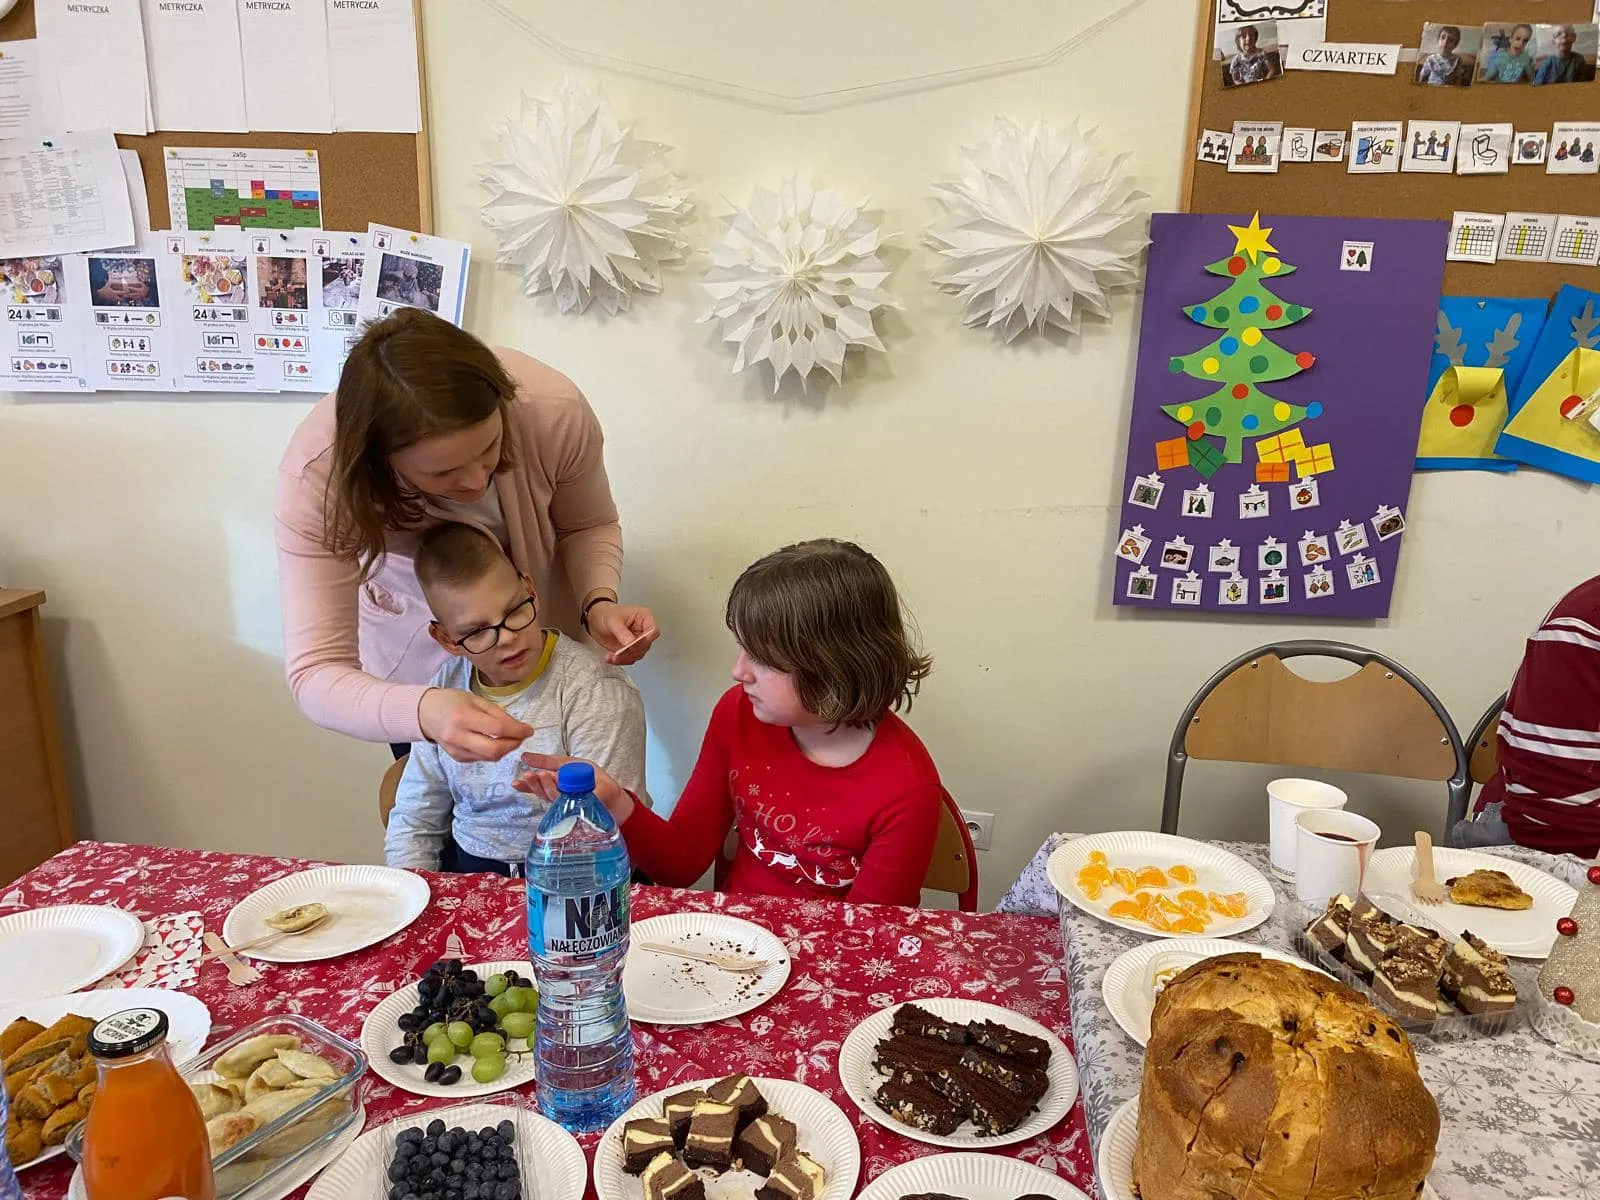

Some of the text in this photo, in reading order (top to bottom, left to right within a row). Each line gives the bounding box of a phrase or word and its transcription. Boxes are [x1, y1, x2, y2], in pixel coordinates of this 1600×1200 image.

[67, 3, 110, 14] METRYCZKA
[159, 2, 203, 12] METRYCZKA
[246, 1, 291, 11] METRYCZKA
[333, 0, 379, 10] METRYCZKA
[1302, 47, 1388, 67] CZWARTEK
[8, 309, 22, 320] 24
[194, 308, 208, 320] 24
